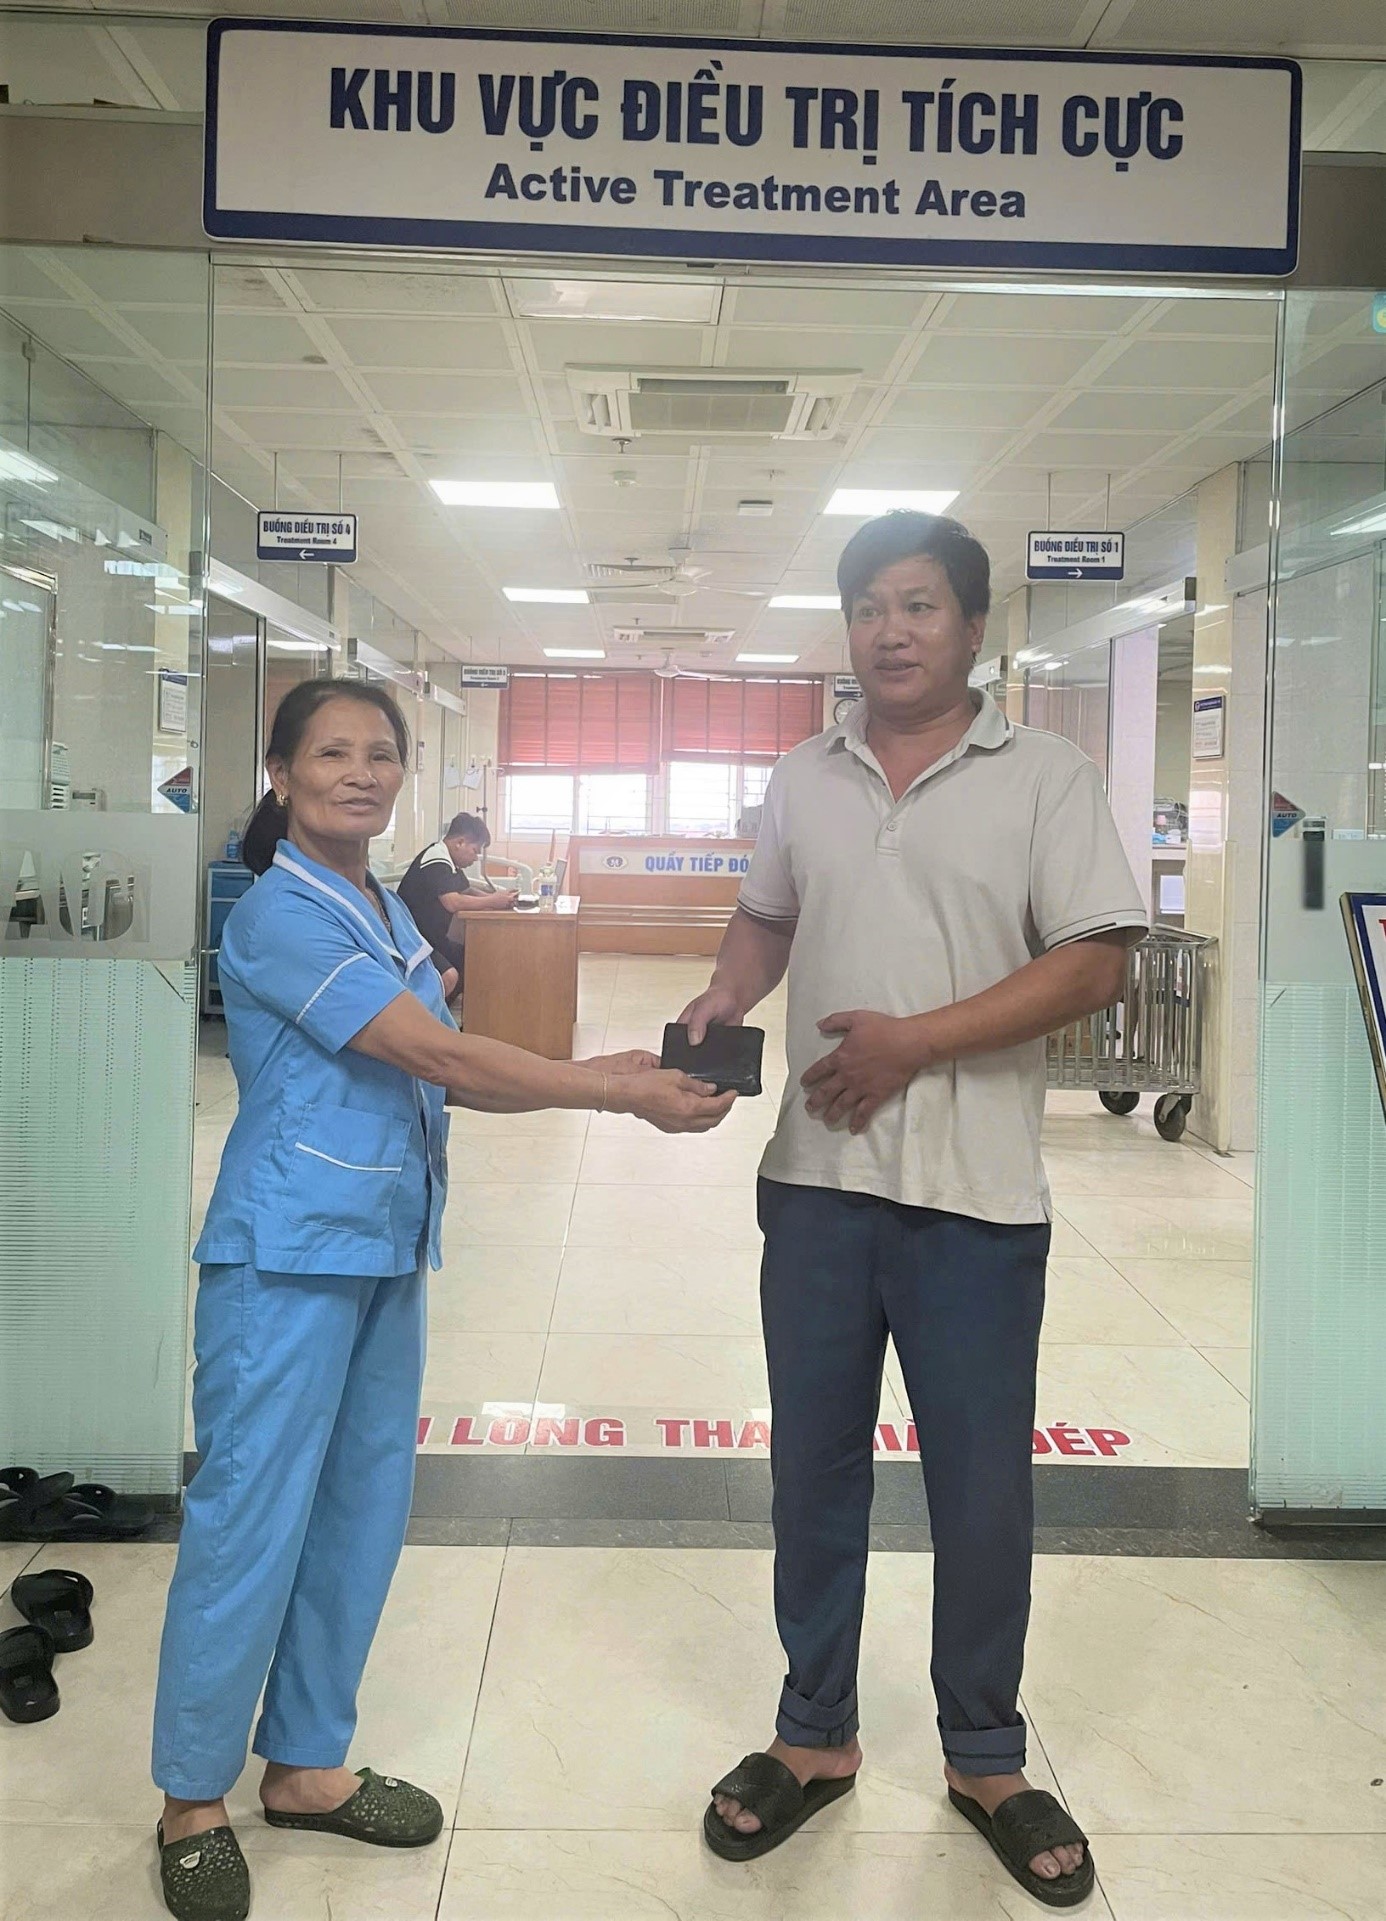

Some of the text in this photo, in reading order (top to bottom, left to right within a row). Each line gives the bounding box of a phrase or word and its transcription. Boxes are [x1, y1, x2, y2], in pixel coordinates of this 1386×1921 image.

[330, 60, 1184, 172] KHU VỰC ĐIỀU TRỊ TÍCH CỰC
[485, 163, 1026, 218] Active Treatment Area
[345, 523, 351, 535] 4
[332, 537, 337, 545] 4
[1114, 542, 1119, 553] 1
[728, 854, 749, 873] ĐÓ
[655, 1419, 770, 1448] THA
